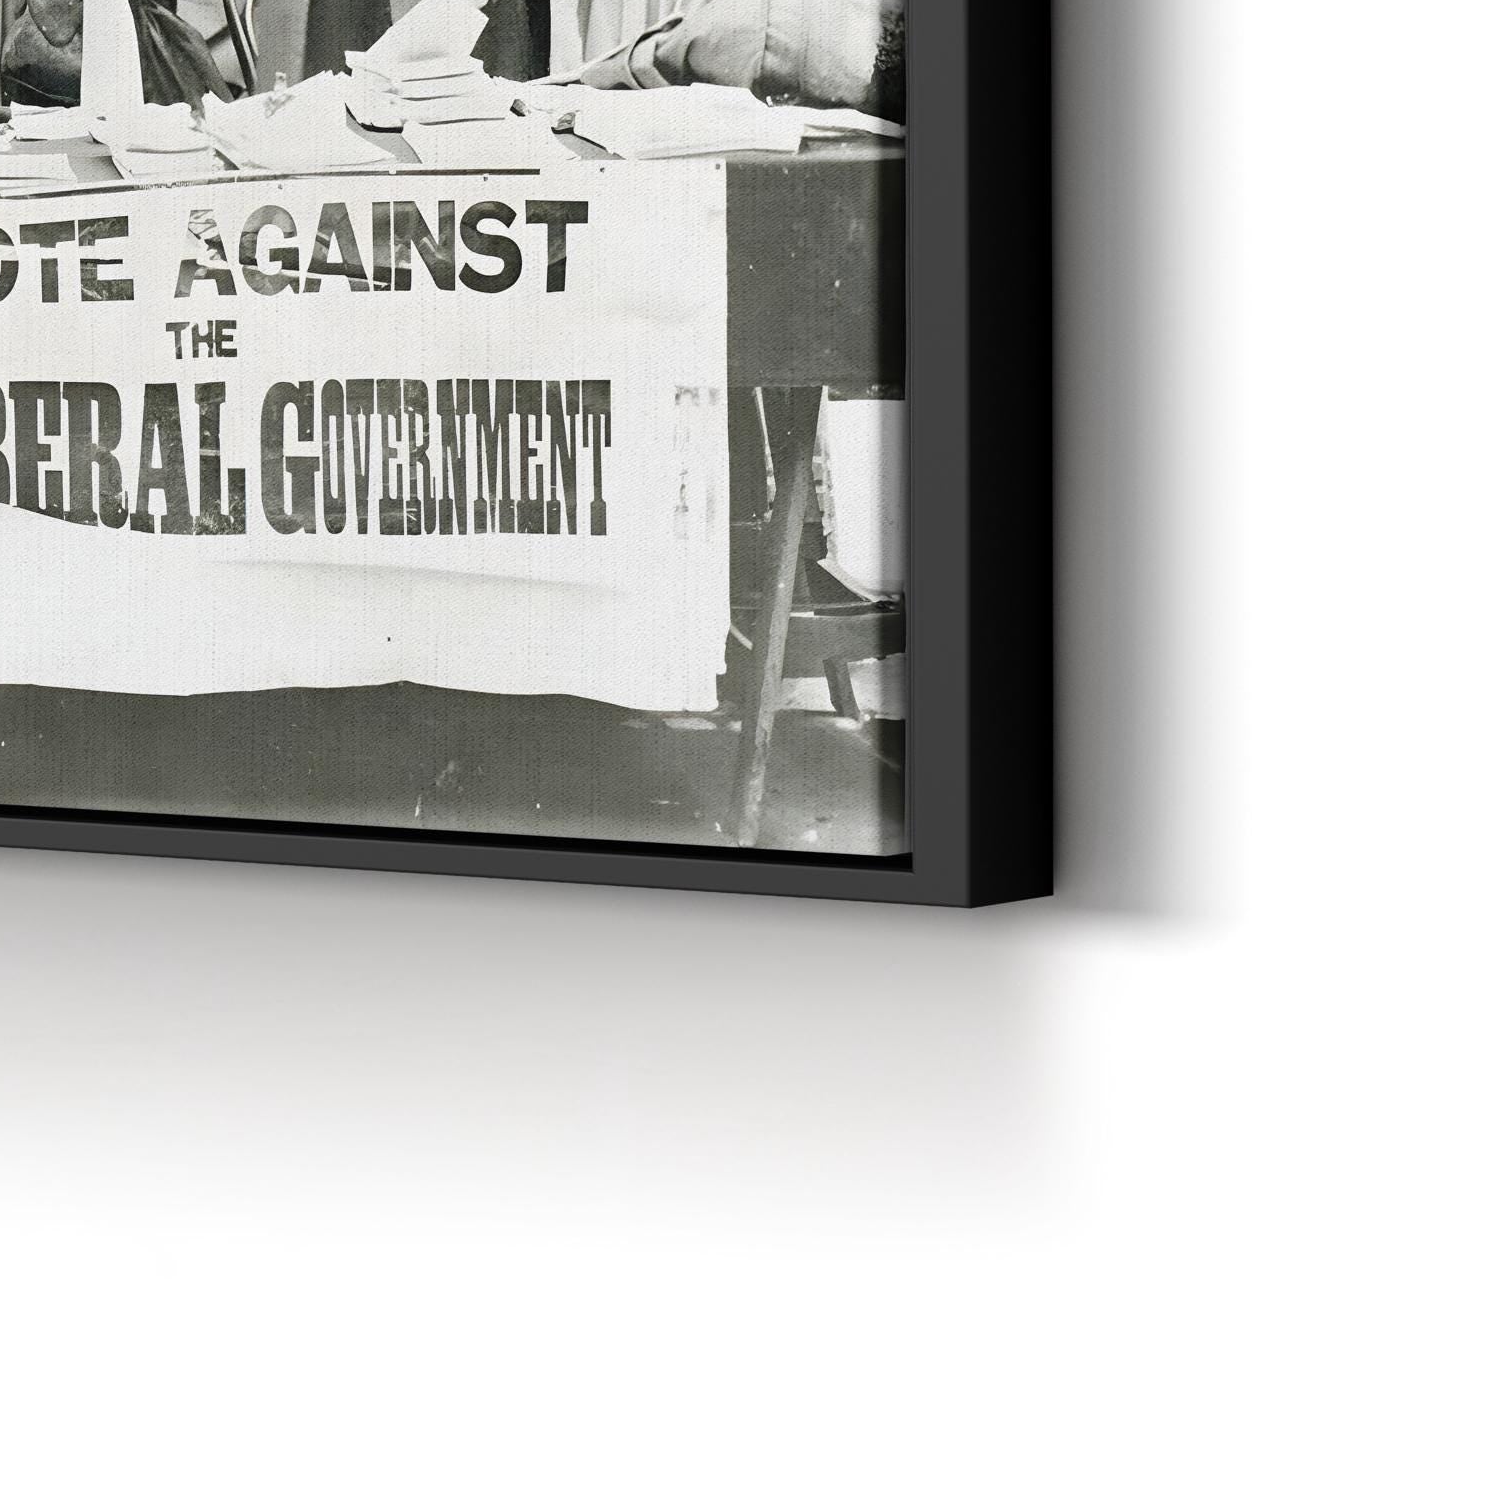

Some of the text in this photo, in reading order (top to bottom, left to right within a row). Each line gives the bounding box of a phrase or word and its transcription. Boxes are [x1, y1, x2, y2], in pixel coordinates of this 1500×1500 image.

[173, 199, 589, 298] AGAINST
[165, 320, 238, 360] THE
[259, 378, 612, 537] GOVERNMENT
